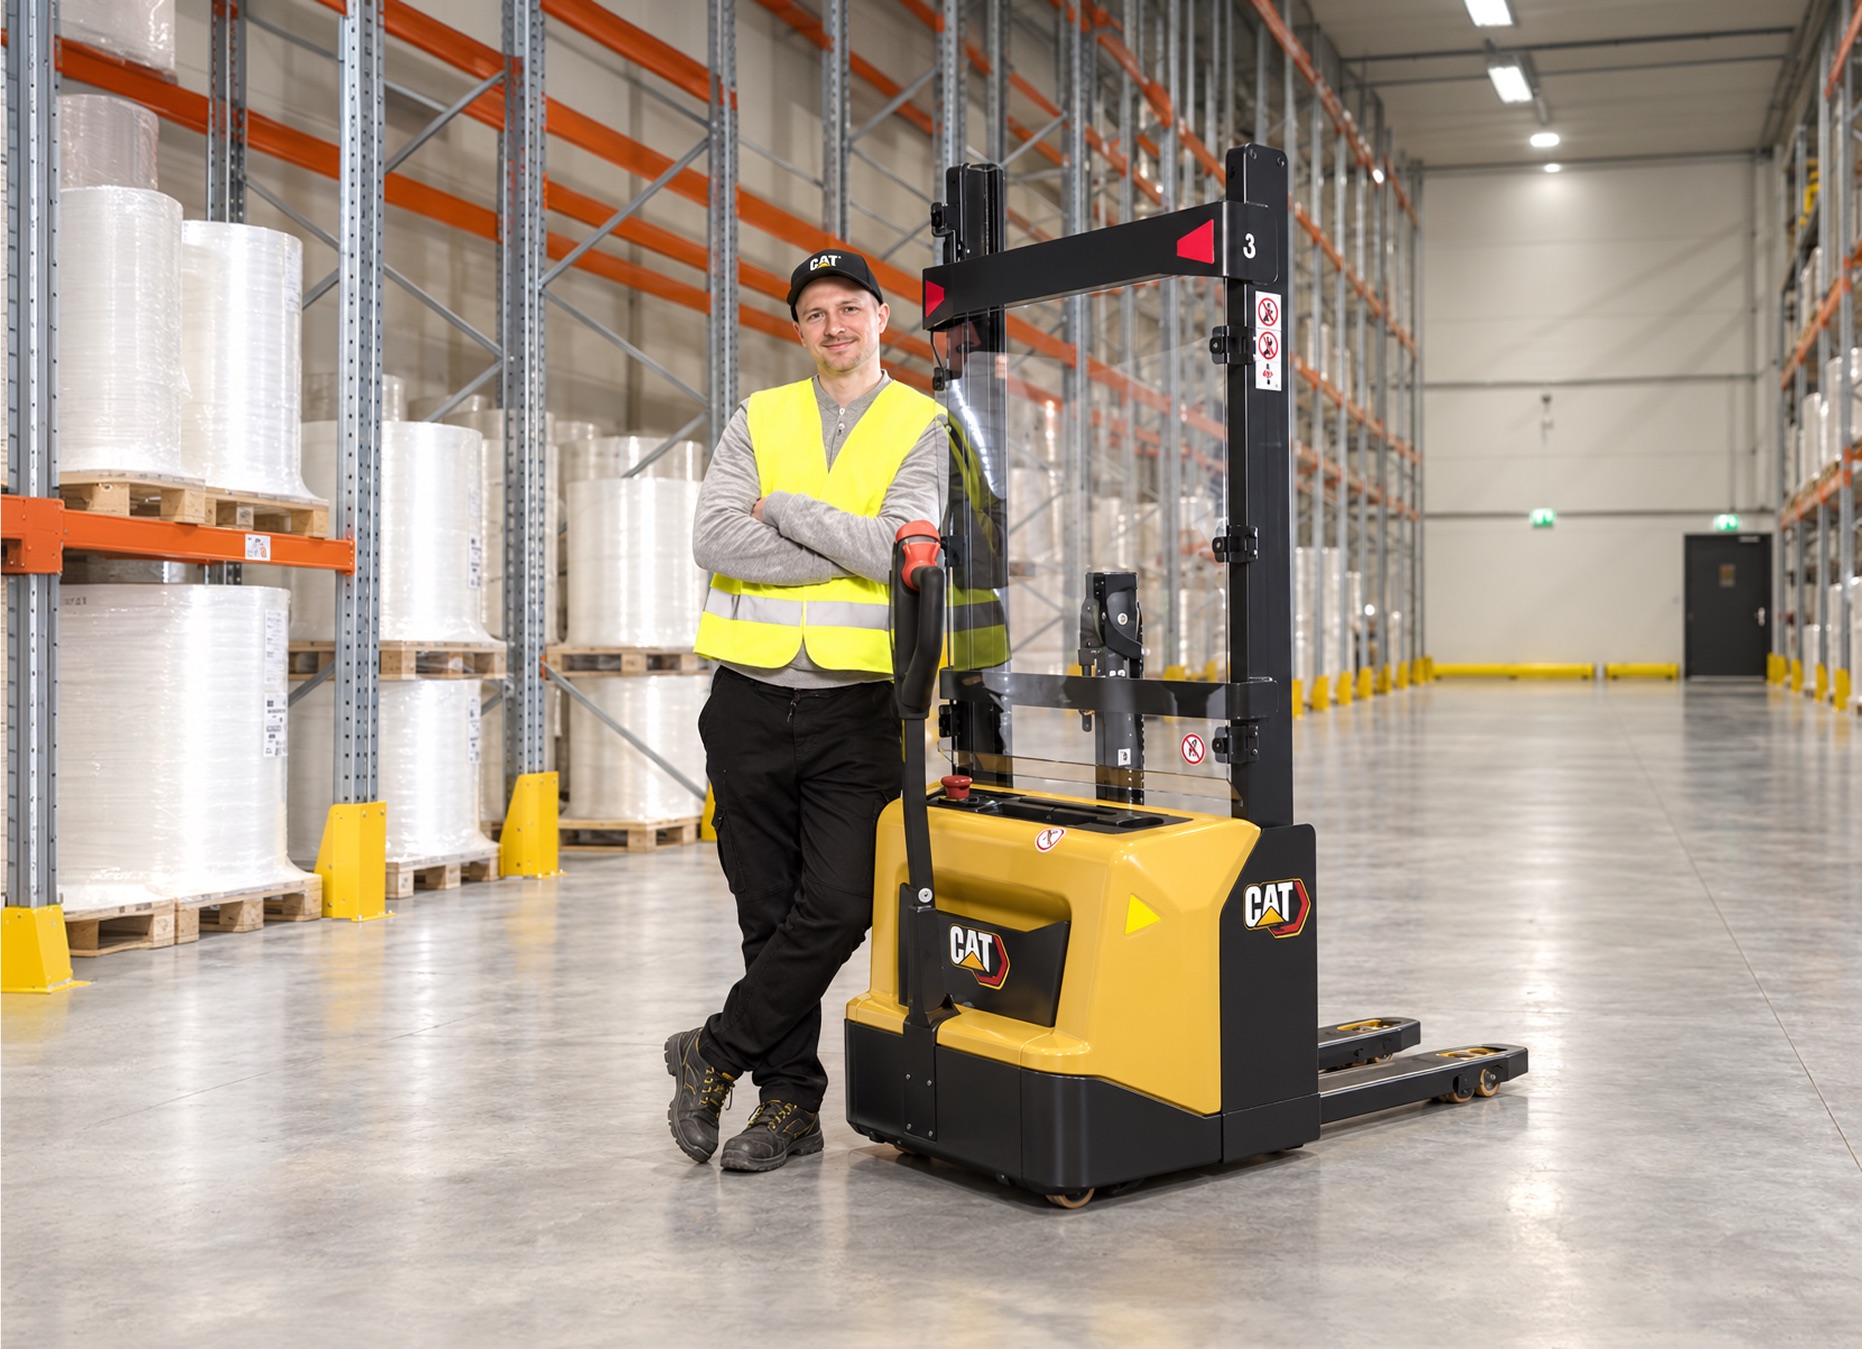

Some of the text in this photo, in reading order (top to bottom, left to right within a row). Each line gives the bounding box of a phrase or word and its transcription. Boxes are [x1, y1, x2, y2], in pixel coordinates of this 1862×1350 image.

[810, 255, 838, 271] CAT
[1243, 233, 1256, 259] 3
[1245, 881, 1293, 927] CAT
[950, 926, 993, 972] CAT
